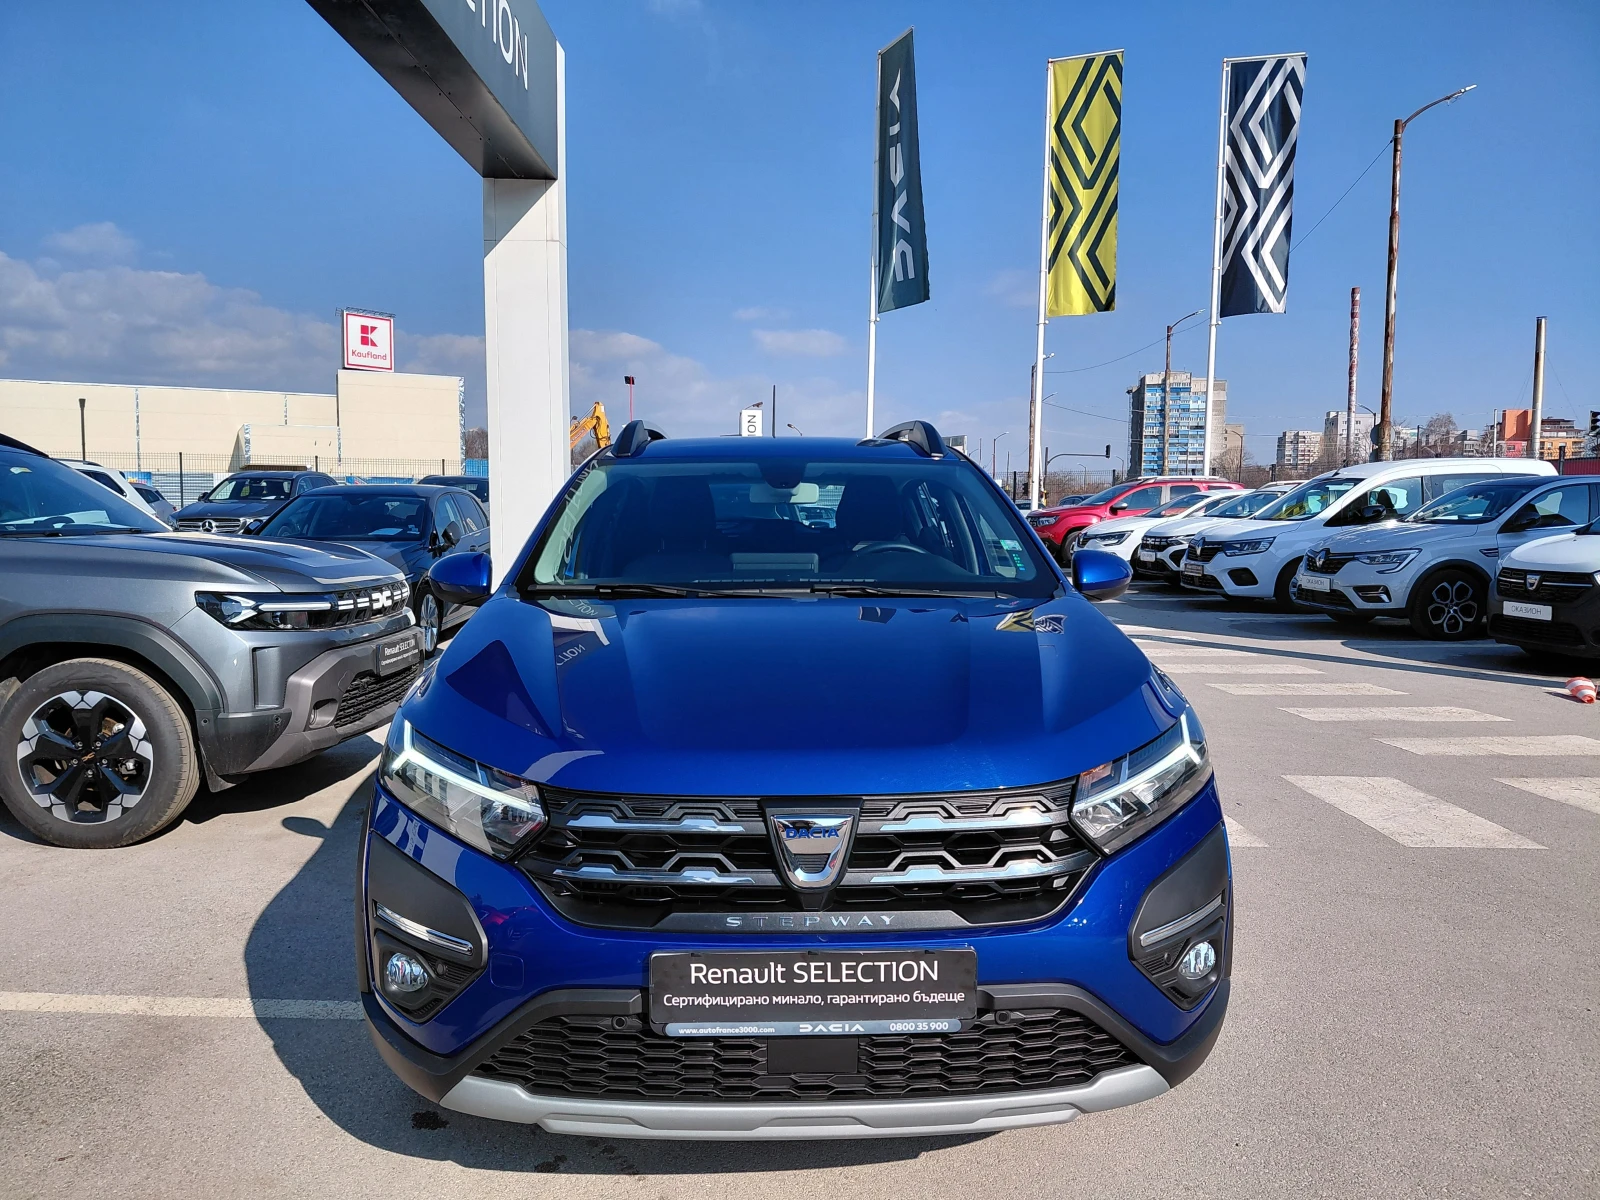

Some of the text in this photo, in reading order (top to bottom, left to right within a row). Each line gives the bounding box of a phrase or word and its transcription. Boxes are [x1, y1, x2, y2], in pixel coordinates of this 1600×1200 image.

[466, 0, 528, 91] ION
[351, 349, 387, 361] Kaufland
[1511, 604, 1542, 615] ОКАЗИОН
[785, 827, 840, 839] DACIA
[725, 915, 895, 928] STEPWAY
[690, 960, 938, 985] Renault SELECTION
[663, 990, 965, 1008] Сертифицирано минало, гарантирано бъдеще
[678, 1026, 776, 1034] www.autofrance3000.com
[799, 1023, 865, 1033] DACIA
[889, 1022, 949, 1032] 0800 35 900
